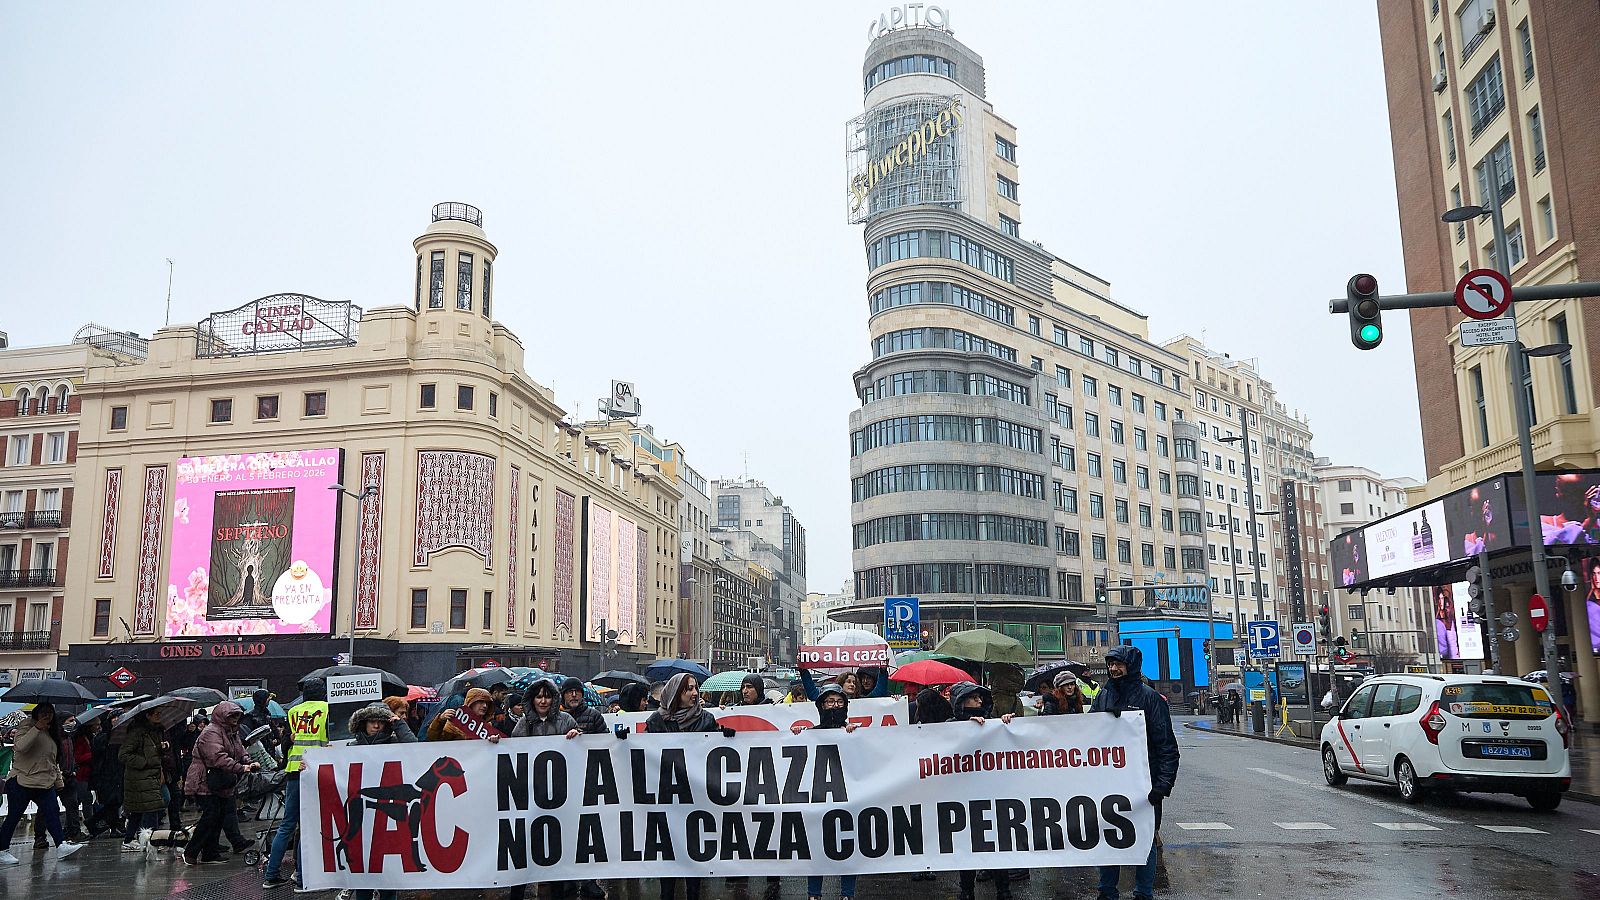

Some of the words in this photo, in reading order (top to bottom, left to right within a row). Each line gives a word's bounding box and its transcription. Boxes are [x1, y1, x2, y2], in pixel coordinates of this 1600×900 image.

[868, 3, 956, 42] CAPITOL
[849, 98, 963, 212] Schweppes
[257, 304, 300, 318] CINES
[242, 316, 314, 335] CALLAO
[287, 456, 336, 468] CALLAO
[202, 474, 232, 482] ENERO
[257, 470, 300, 480] FEBRERO
[304, 469, 326, 478] 2026
[1286, 484, 1294, 515] ROOM
[1289, 525, 1297, 556] MATE
[529, 484, 540, 627] CALLAO
[274, 594, 321, 606] PREVENTA
[284, 584, 297, 594] YA
[300, 584, 312, 593] EN
[1292, 565, 1303, 622] MACAREN
[1252, 626, 1276, 650] P
[160, 645, 202, 658] CINES
[210, 643, 266, 657] CALLAO
[800, 651, 820, 663] no
[823, 651, 832, 662] a
[836, 648, 850, 662] la
[331, 688, 358, 697] SUFREN
[359, 686, 379, 695] IGUAL
[332, 682, 354, 690] TODOS
[356, 680, 377, 688] ELLOS
[291, 710, 324, 734] NAC
[455, 708, 468, 725] no
[468, 720, 477, 732] a
[476, 722, 489, 739] la
[1461, 722, 1470, 732] M
[918, 745, 1127, 779] plataformanac.org
[1488, 746, 1508, 755] 8279
[1512, 746, 1528, 756] KZR
[497, 751, 567, 811] NO
[583, 748, 619, 807] A
[630, 748, 694, 805] LA
[705, 744, 849, 806] CAZA
[317, 756, 469, 873] NAC
[497, 815, 562, 871] NO
[575, 812, 609, 863] A
[619, 811, 676, 862] LA
[685, 810, 812, 863] CAZA
[822, 803, 924, 861] CON
[936, 794, 1137, 854] PERROS
